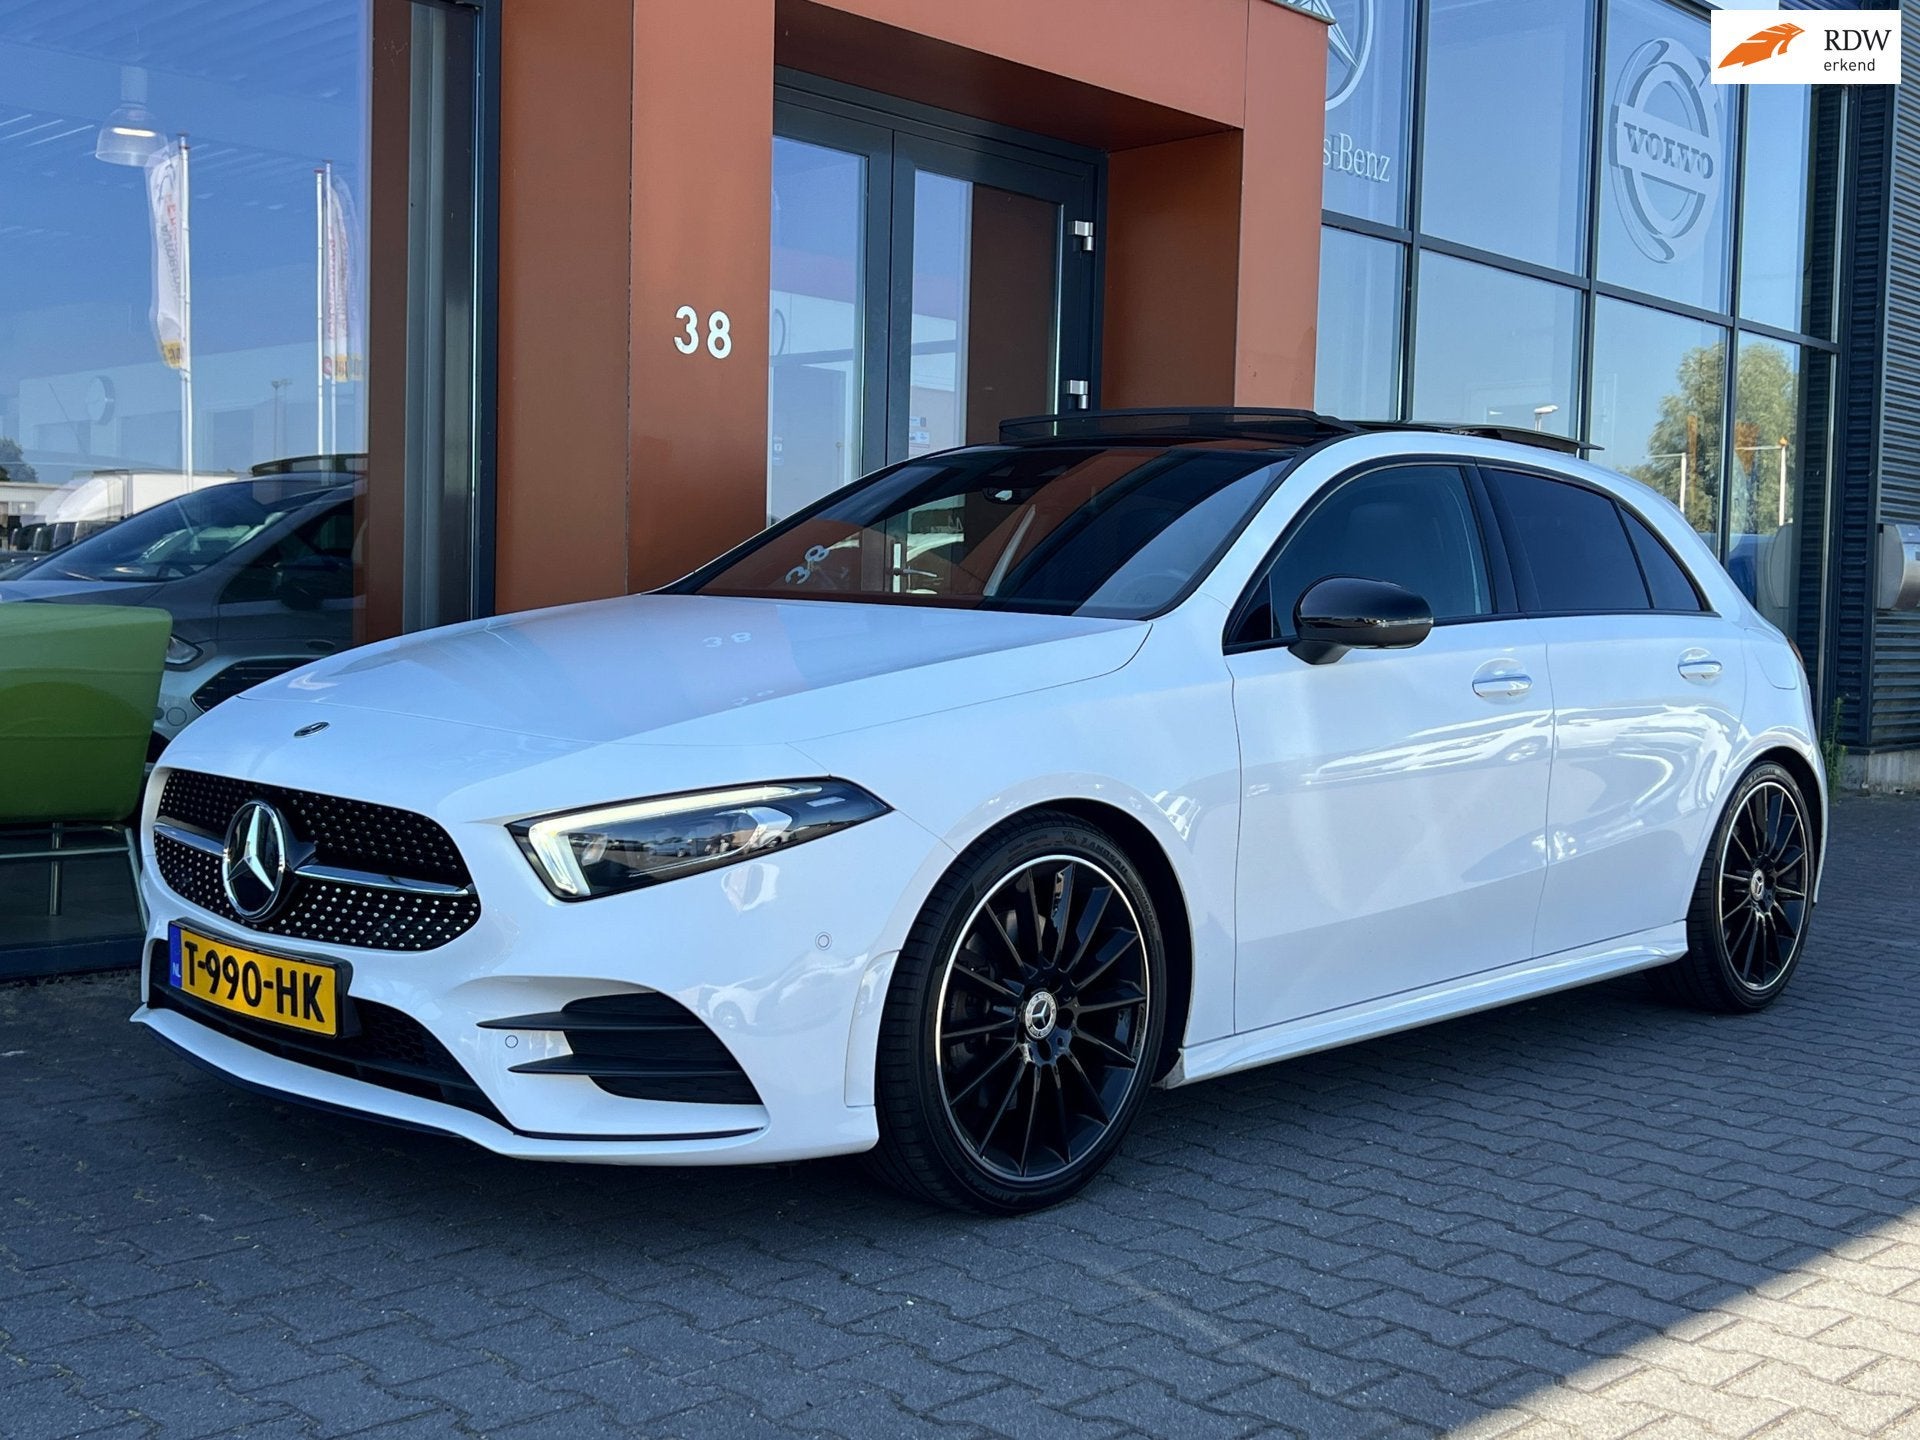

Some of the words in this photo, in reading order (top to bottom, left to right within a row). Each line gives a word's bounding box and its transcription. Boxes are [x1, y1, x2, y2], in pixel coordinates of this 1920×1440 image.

[1623, 121, 1713, 179] VOLVO
[674, 305, 732, 359] 38
[172, 962, 181, 978] NL
[185, 941, 325, 1023] T-990-HK
